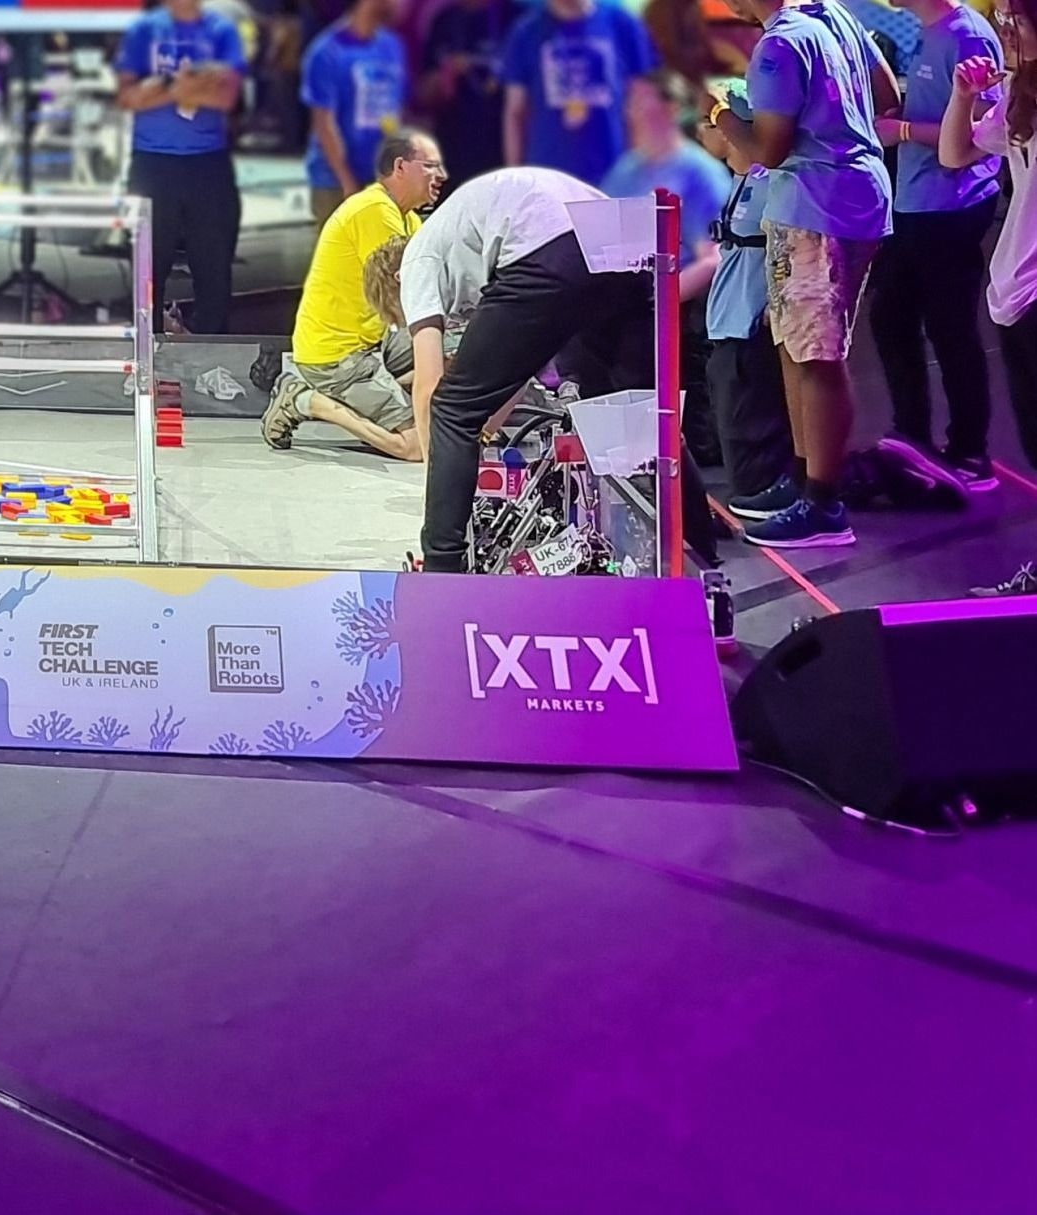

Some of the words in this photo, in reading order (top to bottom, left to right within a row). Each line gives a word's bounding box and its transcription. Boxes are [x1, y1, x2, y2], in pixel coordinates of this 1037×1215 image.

[38, 623, 99, 639] FIRST
[39, 641, 93, 657] TECH
[217, 641, 261, 655] More
[38, 657, 159, 676] CHALLENGE
[218, 656, 261, 670] Than
[62, 677, 81, 687] UK
[85, 677, 94, 687] &
[99, 678, 159, 689] IRELAND
[218, 670, 280, 686] Robots
[526, 697, 606, 712] MARKETS
